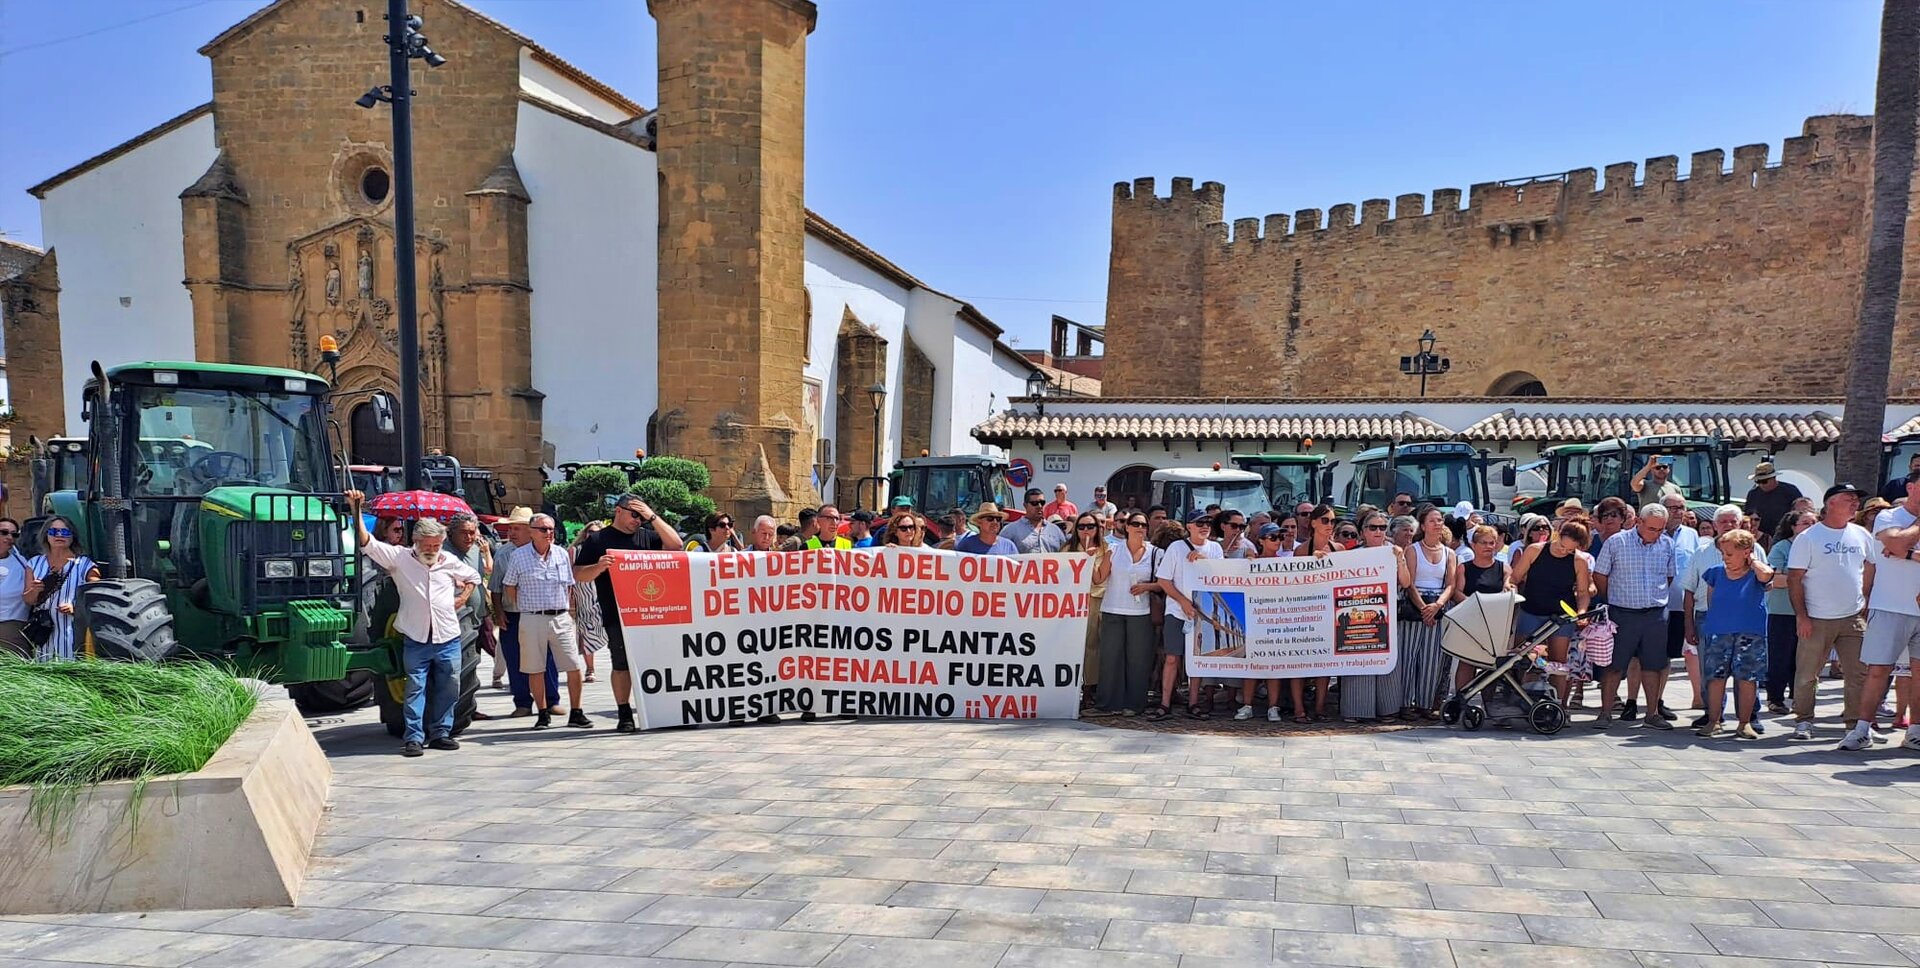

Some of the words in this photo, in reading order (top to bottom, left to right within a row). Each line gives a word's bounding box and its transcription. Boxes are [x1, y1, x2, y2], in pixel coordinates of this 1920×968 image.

[624, 553, 674, 561] PLATAFORMA
[619, 561, 653, 571] CAMPIÑA
[655, 560, 680, 570] NORTE
[709, 553, 756, 587] ¡EN
[766, 549, 888, 578] DEFENSA
[897, 553, 949, 581] DEL
[959, 556, 1059, 585] OLIVAR
[1068, 558, 1087, 584] Y
[1249, 558, 1334, 572] PLATAFORMA
[1255, 576, 1280, 585] POR
[1284, 575, 1300, 585] LA
[1337, 585, 1383, 597] LOPERA
[704, 588, 740, 617] DE
[748, 582, 870, 614] NUESTRO
[877, 587, 963, 617] MEDIO
[972, 590, 1006, 618] DE
[1014, 592, 1089, 619] VIDA!!
[1249, 596, 1277, 605] Exigimos
[1337, 597, 1384, 607] RESIDENCIA
[649, 605, 688, 613] Megaplantas
[1253, 606, 1278, 615] Aprobar
[1279, 605, 1286, 613] la
[1286, 603, 1327, 613] convocatoria
[1275, 616, 1292, 625] pleno
[1293, 613, 1323, 623] ordinario
[1266, 626, 1281, 635] para
[1282, 625, 1307, 633] abordar
[682, 631, 726, 658] NO
[737, 623, 893, 656] QUEREMOS
[903, 628, 1036, 656] PLANTAS
[1255, 637, 1274, 645] cesión
[1268, 649, 1287, 657] MÁS
[1288, 648, 1330, 657] EXCUSAS!
[1244, 663, 1249, 671] y
[1250, 662, 1269, 670] futuro
[1271, 663, 1285, 671] para
[1313, 661, 1339, 669] mayores
[948, 662, 1045, 688] FUERA
[682, 687, 814, 725] NUESTRO
[821, 689, 955, 718] TERMINO
[965, 695, 1037, 719] ¡¡YA!!
